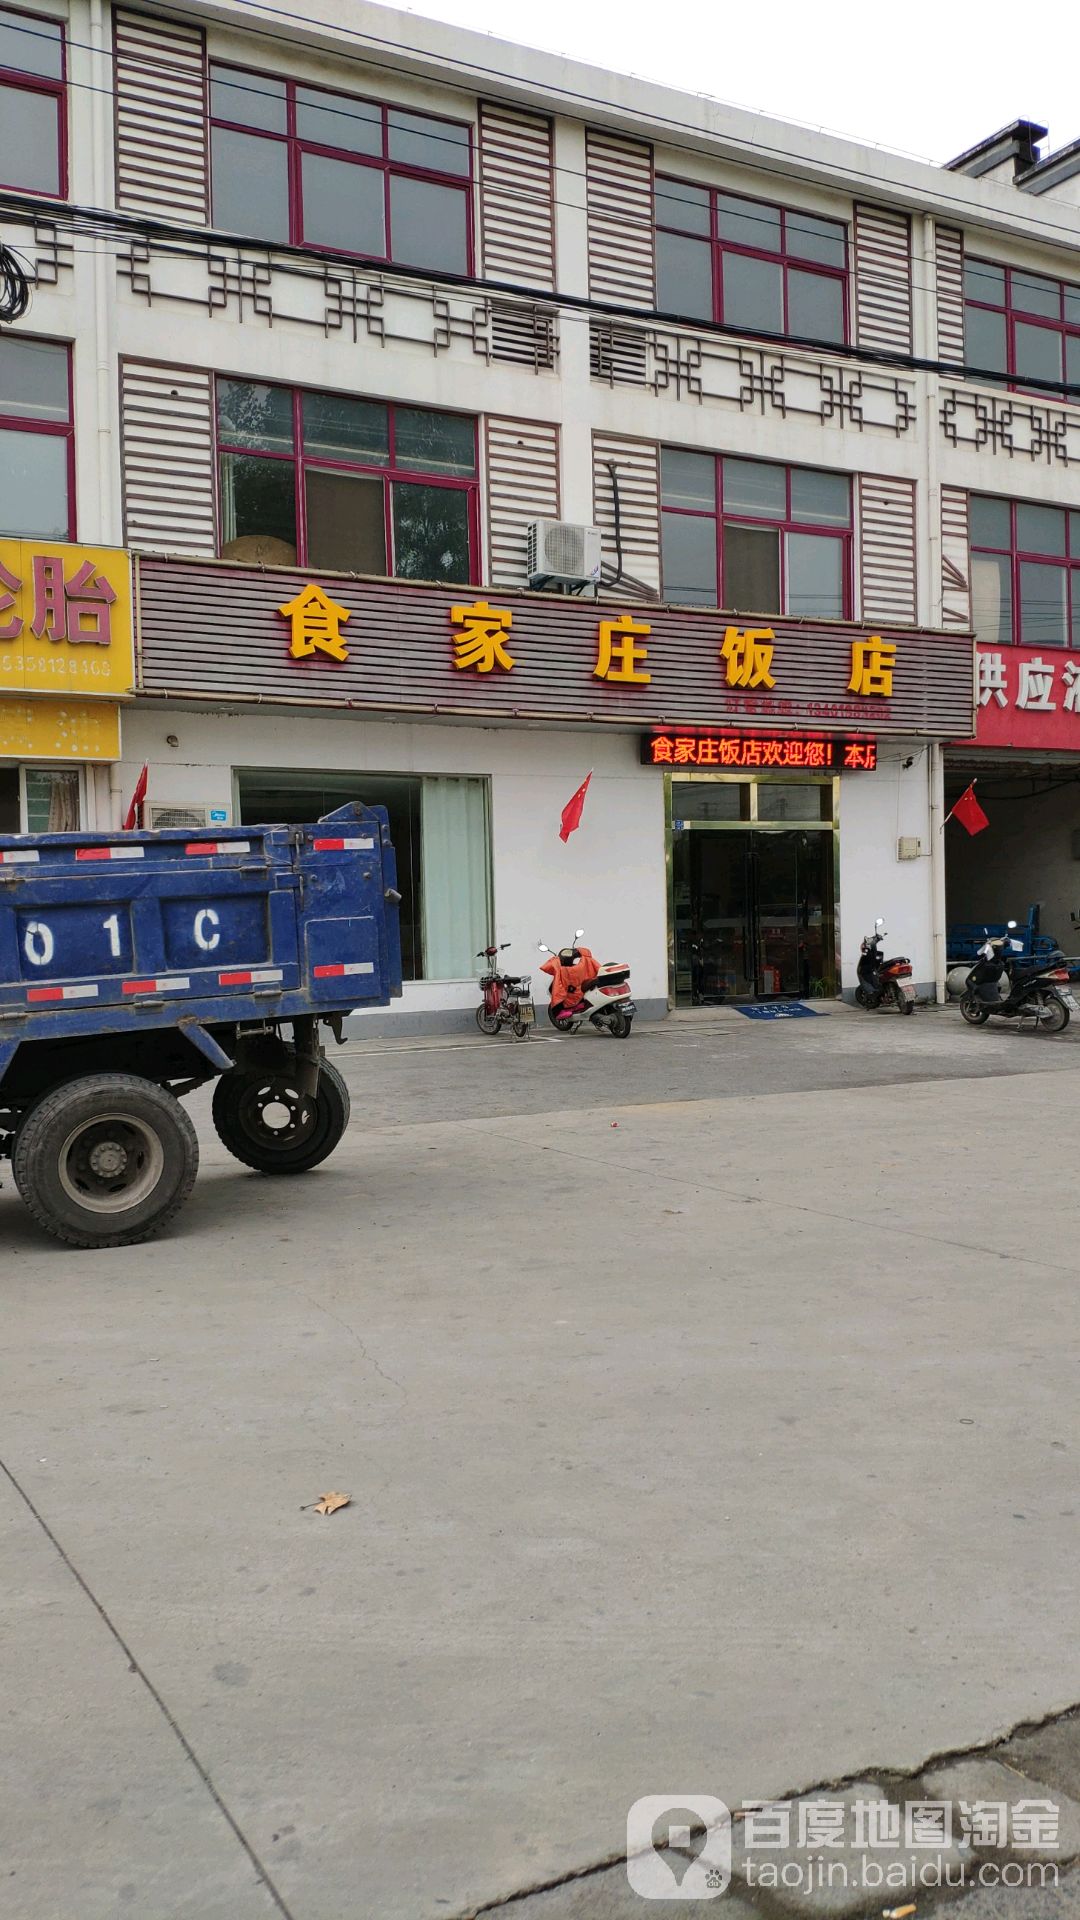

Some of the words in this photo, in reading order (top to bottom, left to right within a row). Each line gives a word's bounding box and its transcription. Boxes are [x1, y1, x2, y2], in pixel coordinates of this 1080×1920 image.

[279, 583, 897, 698] 食家庄饭店
